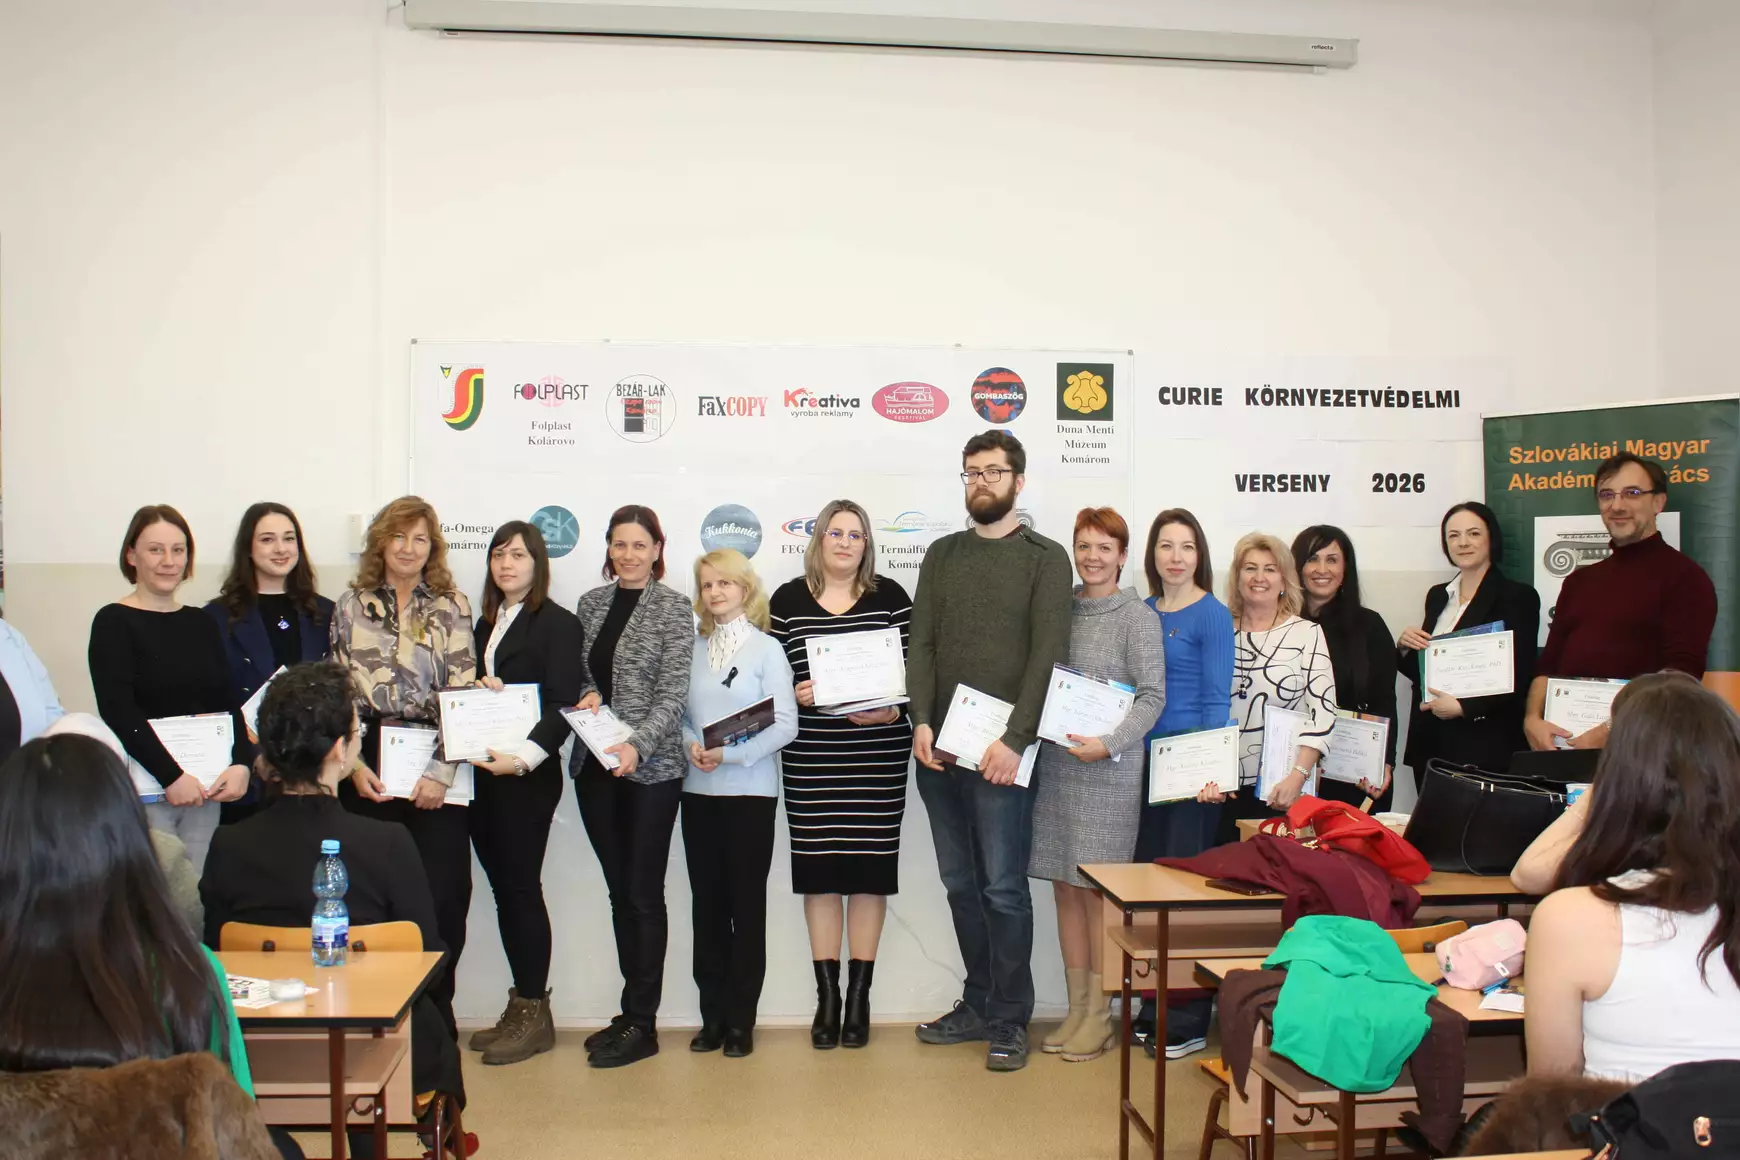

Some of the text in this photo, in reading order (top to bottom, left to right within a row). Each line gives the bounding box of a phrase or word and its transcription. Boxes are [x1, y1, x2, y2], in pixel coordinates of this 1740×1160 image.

[513, 383, 590, 401] FOLPLAST
[616, 381, 666, 397] BEZÁR-LAK
[783, 387, 861, 408] Kreativa
[974, 392, 1024, 400] GOMBASZÖG
[1158, 384, 1460, 409] CURIE KÖRNYEZETVÉDELMI
[821, 409, 854, 418] reklamy
[531, 420, 572, 432] Folplast
[1056, 424, 1114, 434] Duna Menti
[528, 436, 575, 445] Kolárovo
[1064, 439, 1107, 449] Múzeum
[1509, 439, 1711, 464] Szlovákiai Magyar
[1061, 454, 1110, 464] Komárom
[1235, 473, 1426, 493] VERSENY 2026
[1508, 464, 1711, 491] Akadém ács
[439, 522, 494, 535] fa-Omega
[705, 522, 758, 539] Kukkonia
[781, 544, 805, 554] FEG
[879, 544, 928, 554] Termálfü
